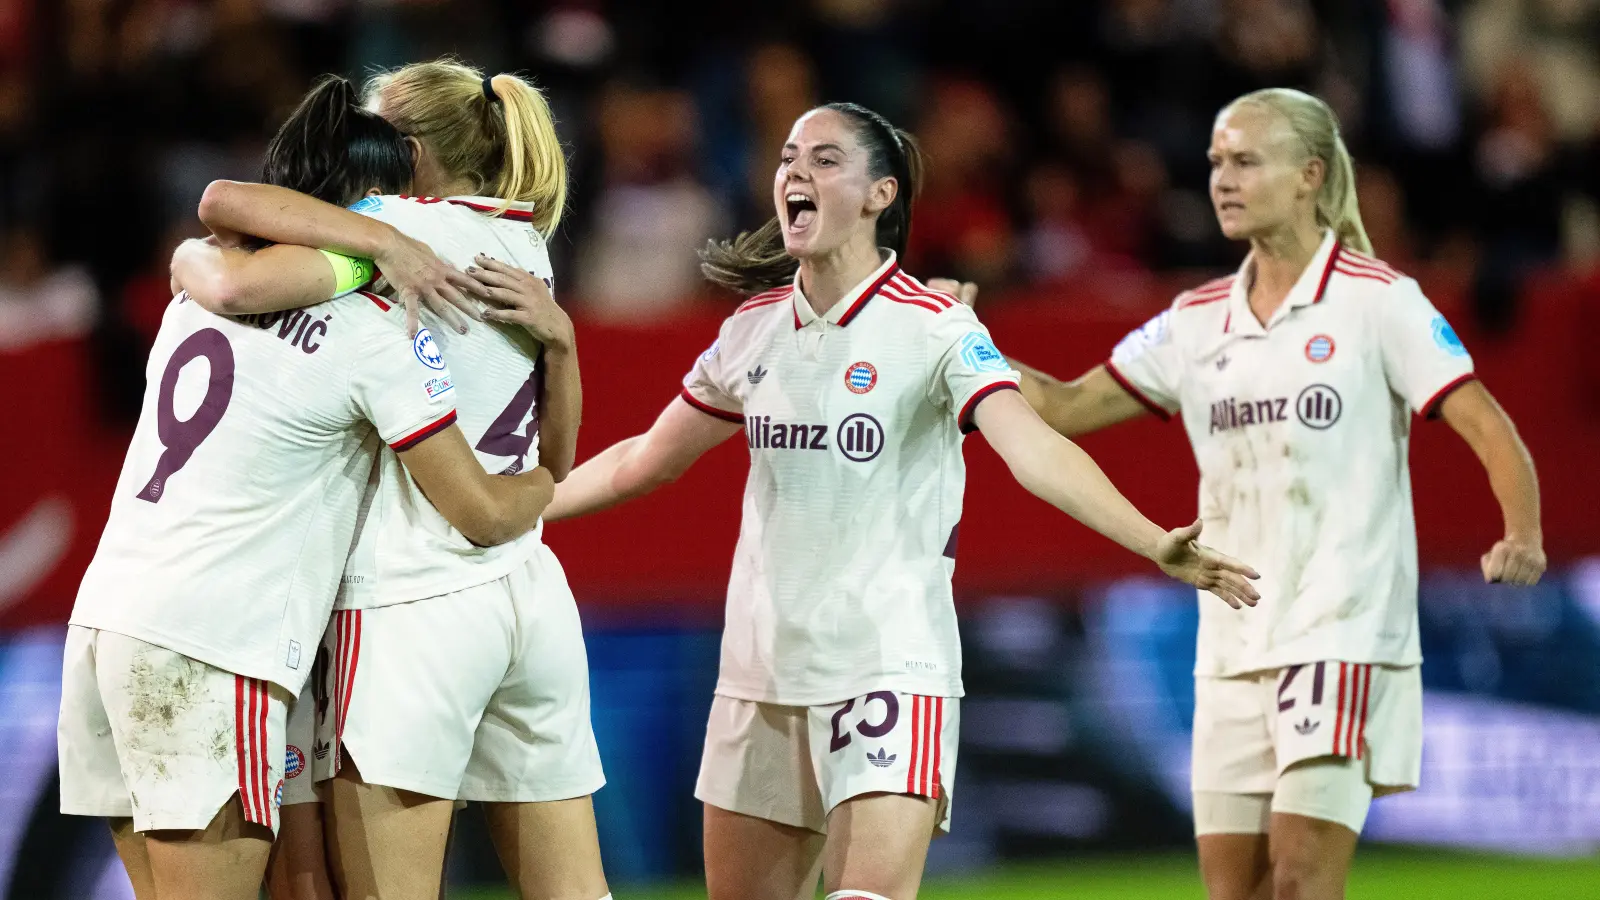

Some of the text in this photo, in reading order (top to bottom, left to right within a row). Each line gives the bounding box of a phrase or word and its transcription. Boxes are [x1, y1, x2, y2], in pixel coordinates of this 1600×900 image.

[135, 327, 235, 503] 9
[475, 365, 541, 475] 4
[1209, 397, 1288, 436] Allianz
[1277, 661, 1326, 713] 21
[829, 690, 900, 754] 25
